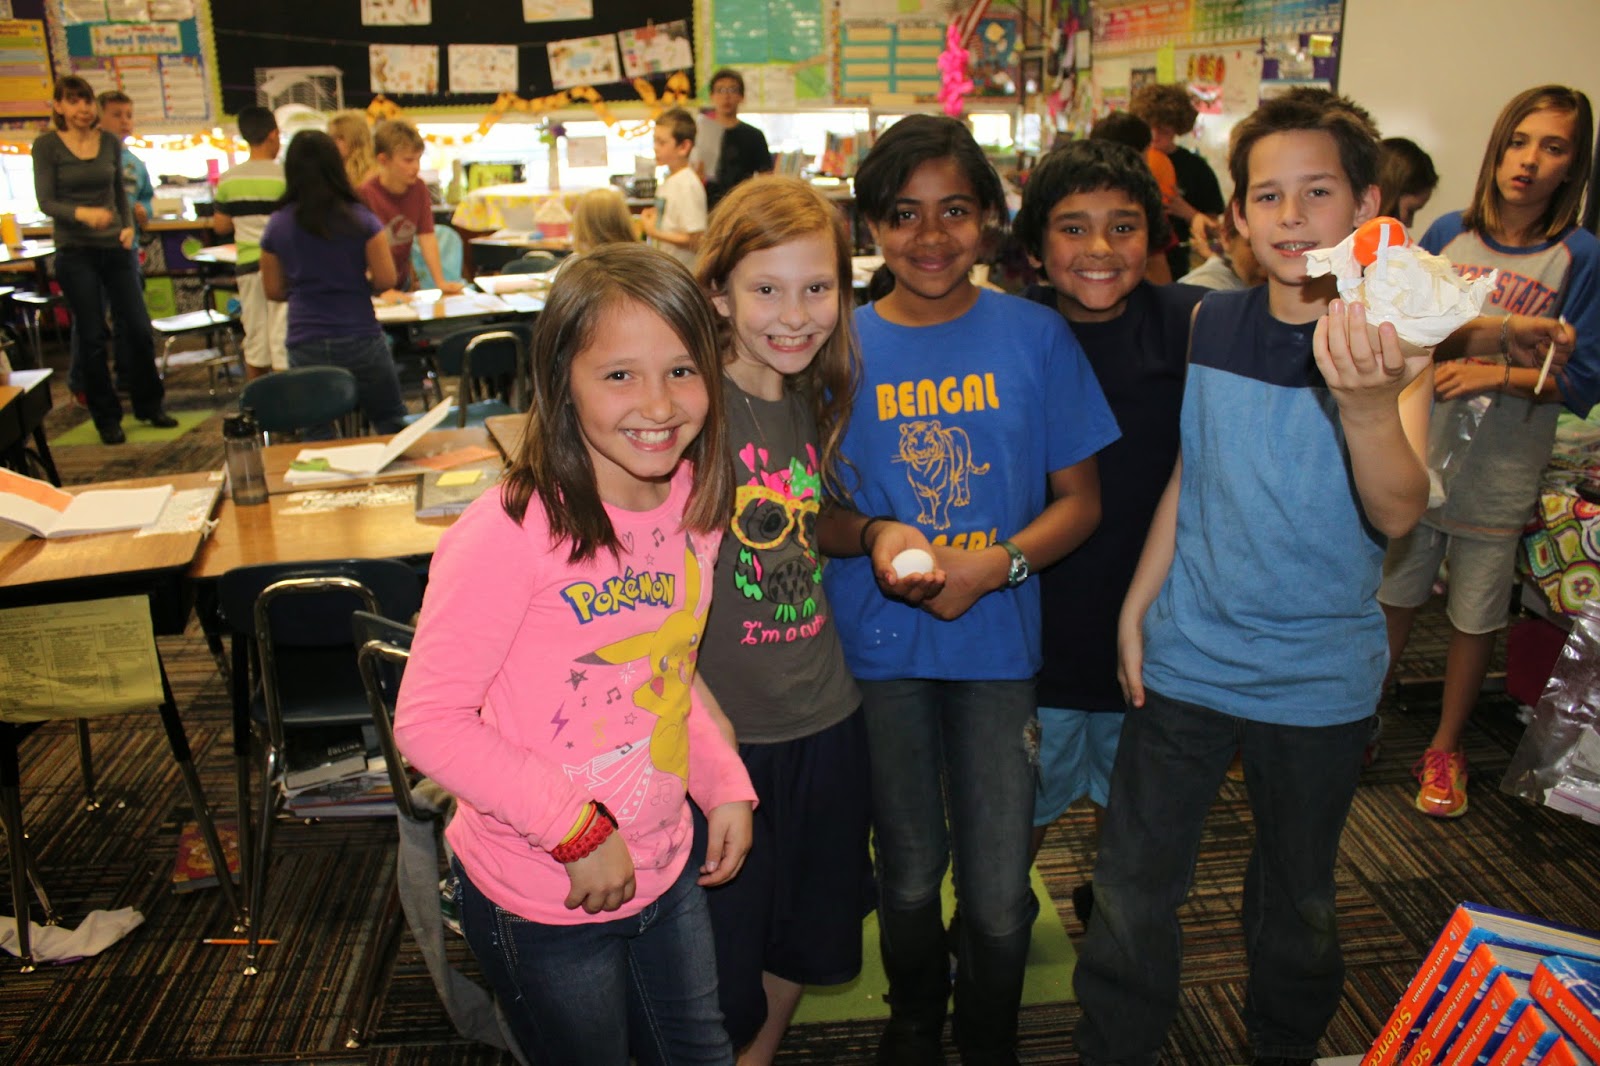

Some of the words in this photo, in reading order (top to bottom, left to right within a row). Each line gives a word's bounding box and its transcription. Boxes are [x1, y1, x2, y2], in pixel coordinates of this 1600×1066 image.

[876, 372, 1000, 421] BENGAL
[740, 620, 780, 645] I'm
[1435, 944, 1449, 966] Scott
[1412, 966, 1437, 1003] Foresman
[1455, 981, 1470, 1002] Scott
[1431, 1001, 1457, 1039] Foresman
[1556, 998, 1577, 1023] Scott
[1368, 1006, 1412, 1066] Science
[1475, 1013, 1491, 1035] Scott
[1500, 1044, 1517, 1066] Scott
